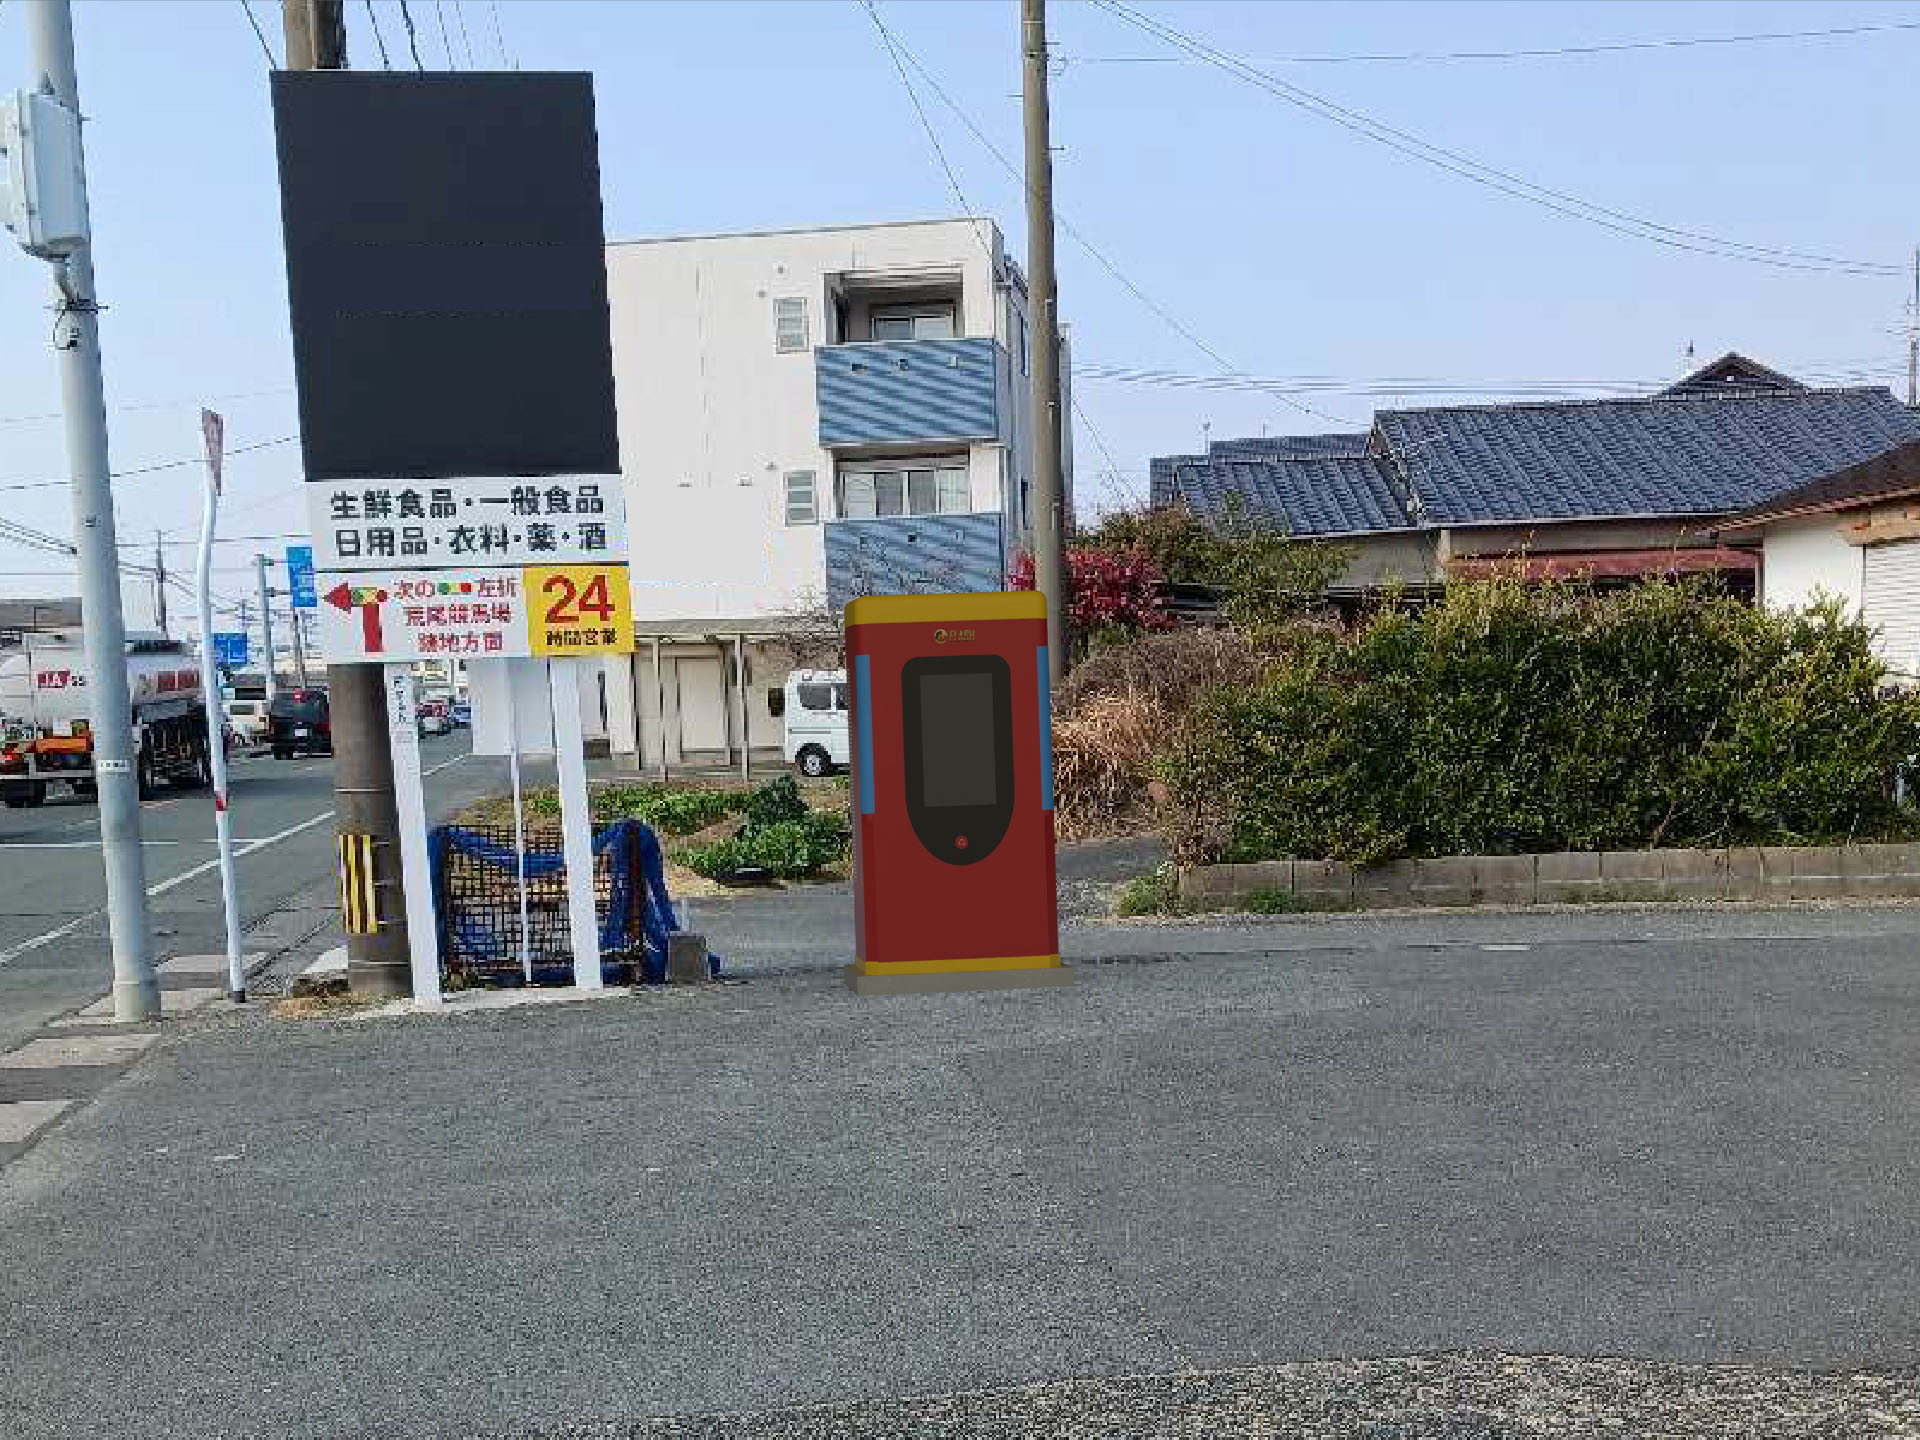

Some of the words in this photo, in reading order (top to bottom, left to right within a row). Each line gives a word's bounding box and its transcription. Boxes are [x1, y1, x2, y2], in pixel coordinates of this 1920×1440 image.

[330, 485, 604, 520] 生鮮食品・一般食品
[335, 523, 606, 557] 日用品・衣料・薬・酒
[543, 574, 616, 624] 24
